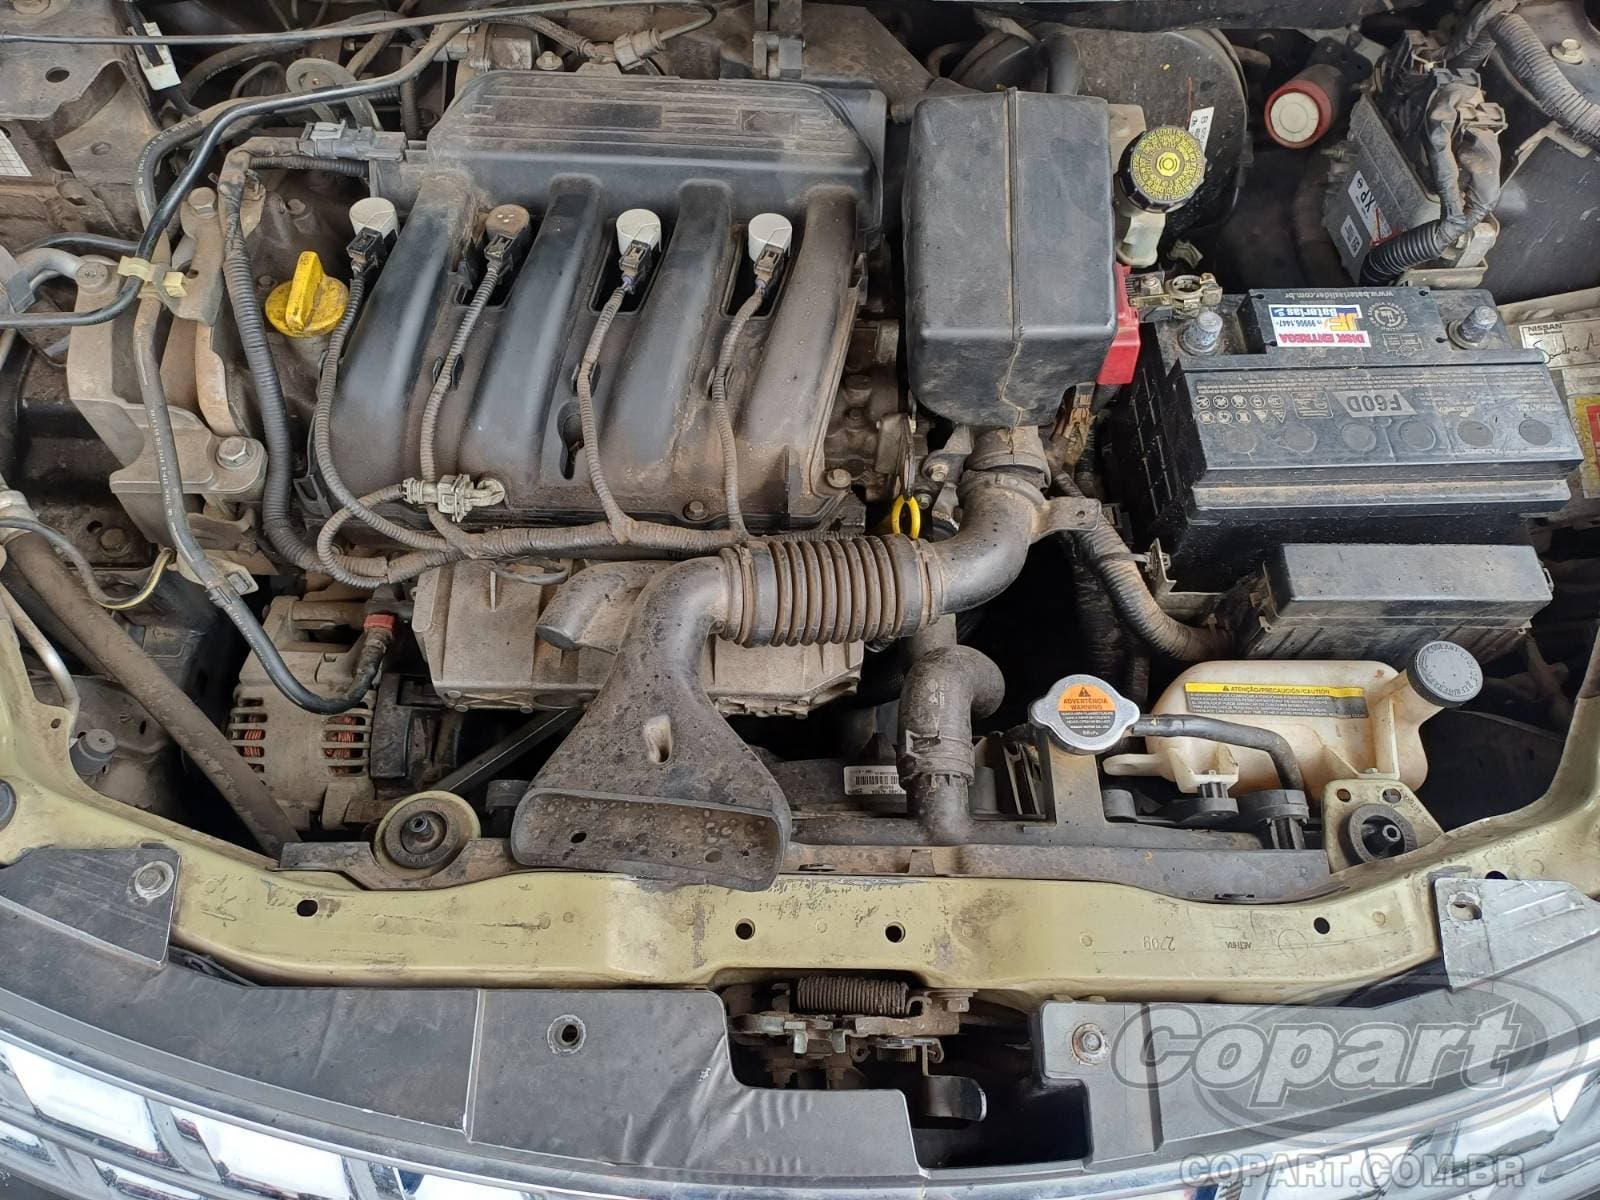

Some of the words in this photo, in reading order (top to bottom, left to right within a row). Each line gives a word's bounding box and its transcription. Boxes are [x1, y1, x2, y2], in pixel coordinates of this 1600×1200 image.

[1286, 307, 1337, 317] Baterias
[1527, 323, 1563, 332] NISSAN
[1279, 333, 1334, 344] ENTREGA
[1336, 333, 1365, 343] DISK
[1346, 394, 1402, 413] F60D
